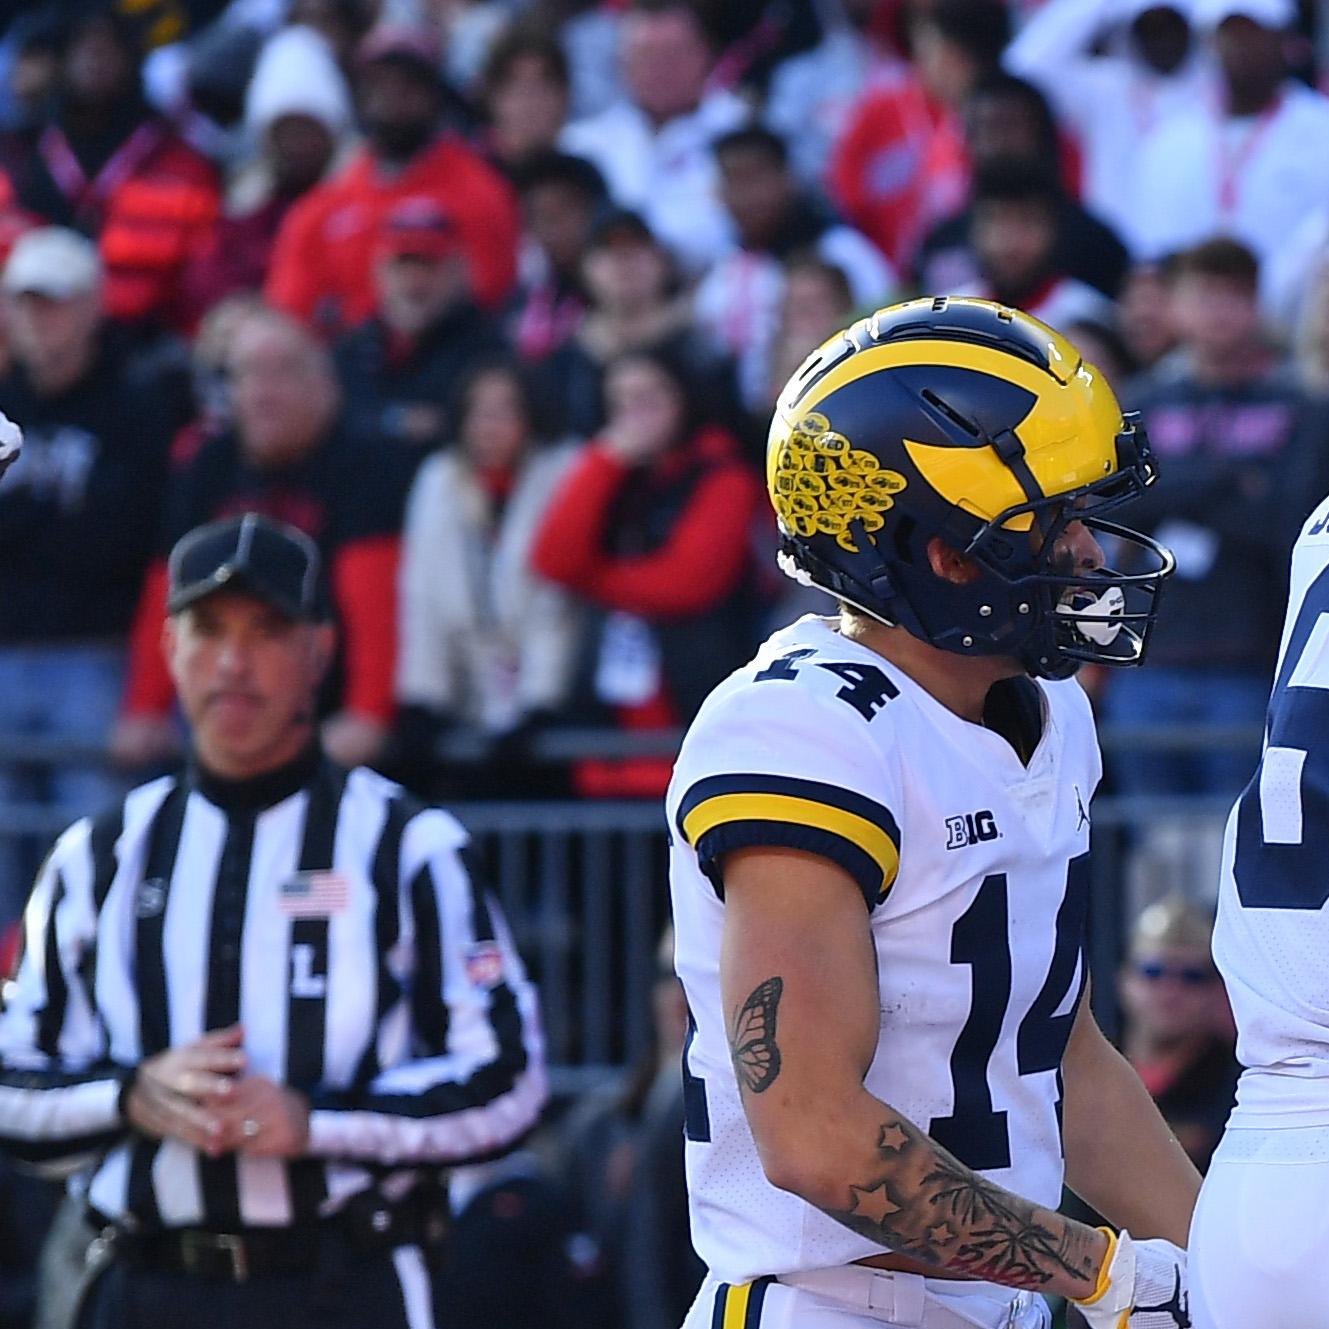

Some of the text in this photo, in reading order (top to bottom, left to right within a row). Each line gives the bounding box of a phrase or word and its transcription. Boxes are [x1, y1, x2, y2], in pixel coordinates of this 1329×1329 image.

[752, 647, 902, 722] 14
[293, 943, 326, 998] L
[928, 851, 1091, 1170] 14
